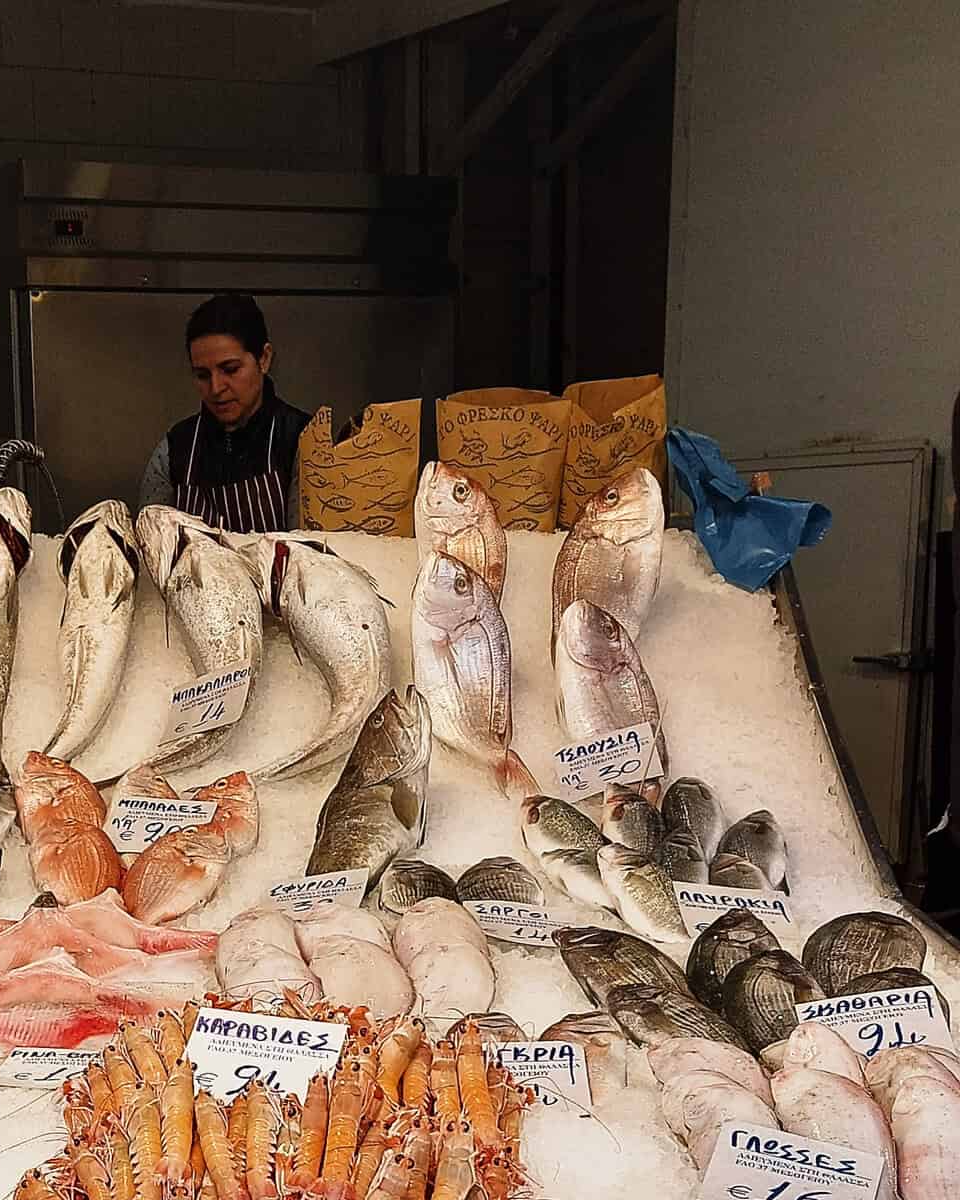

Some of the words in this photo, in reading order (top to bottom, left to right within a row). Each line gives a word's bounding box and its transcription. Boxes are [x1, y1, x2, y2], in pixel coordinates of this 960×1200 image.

[457, 407, 525, 424] ΦΡΕΣΚΟ
[529, 411, 564, 442] ΨΑΡΙ
[554, 731, 641, 763] ΤΣΑΟΥΣΙΑ
[598, 759, 641, 782] 30
[270, 877, 347, 896] ΣΦΥΡΙΔΑ
[474, 903, 549, 920] ΣΑΡΓΟΙ
[196, 1016, 339, 1053] ΚΑΡΑΒΙΔΕΣ
[497, 1044, 575, 1085] ΓΚΡΙΑ
[726, 1185, 753, 1200] €
